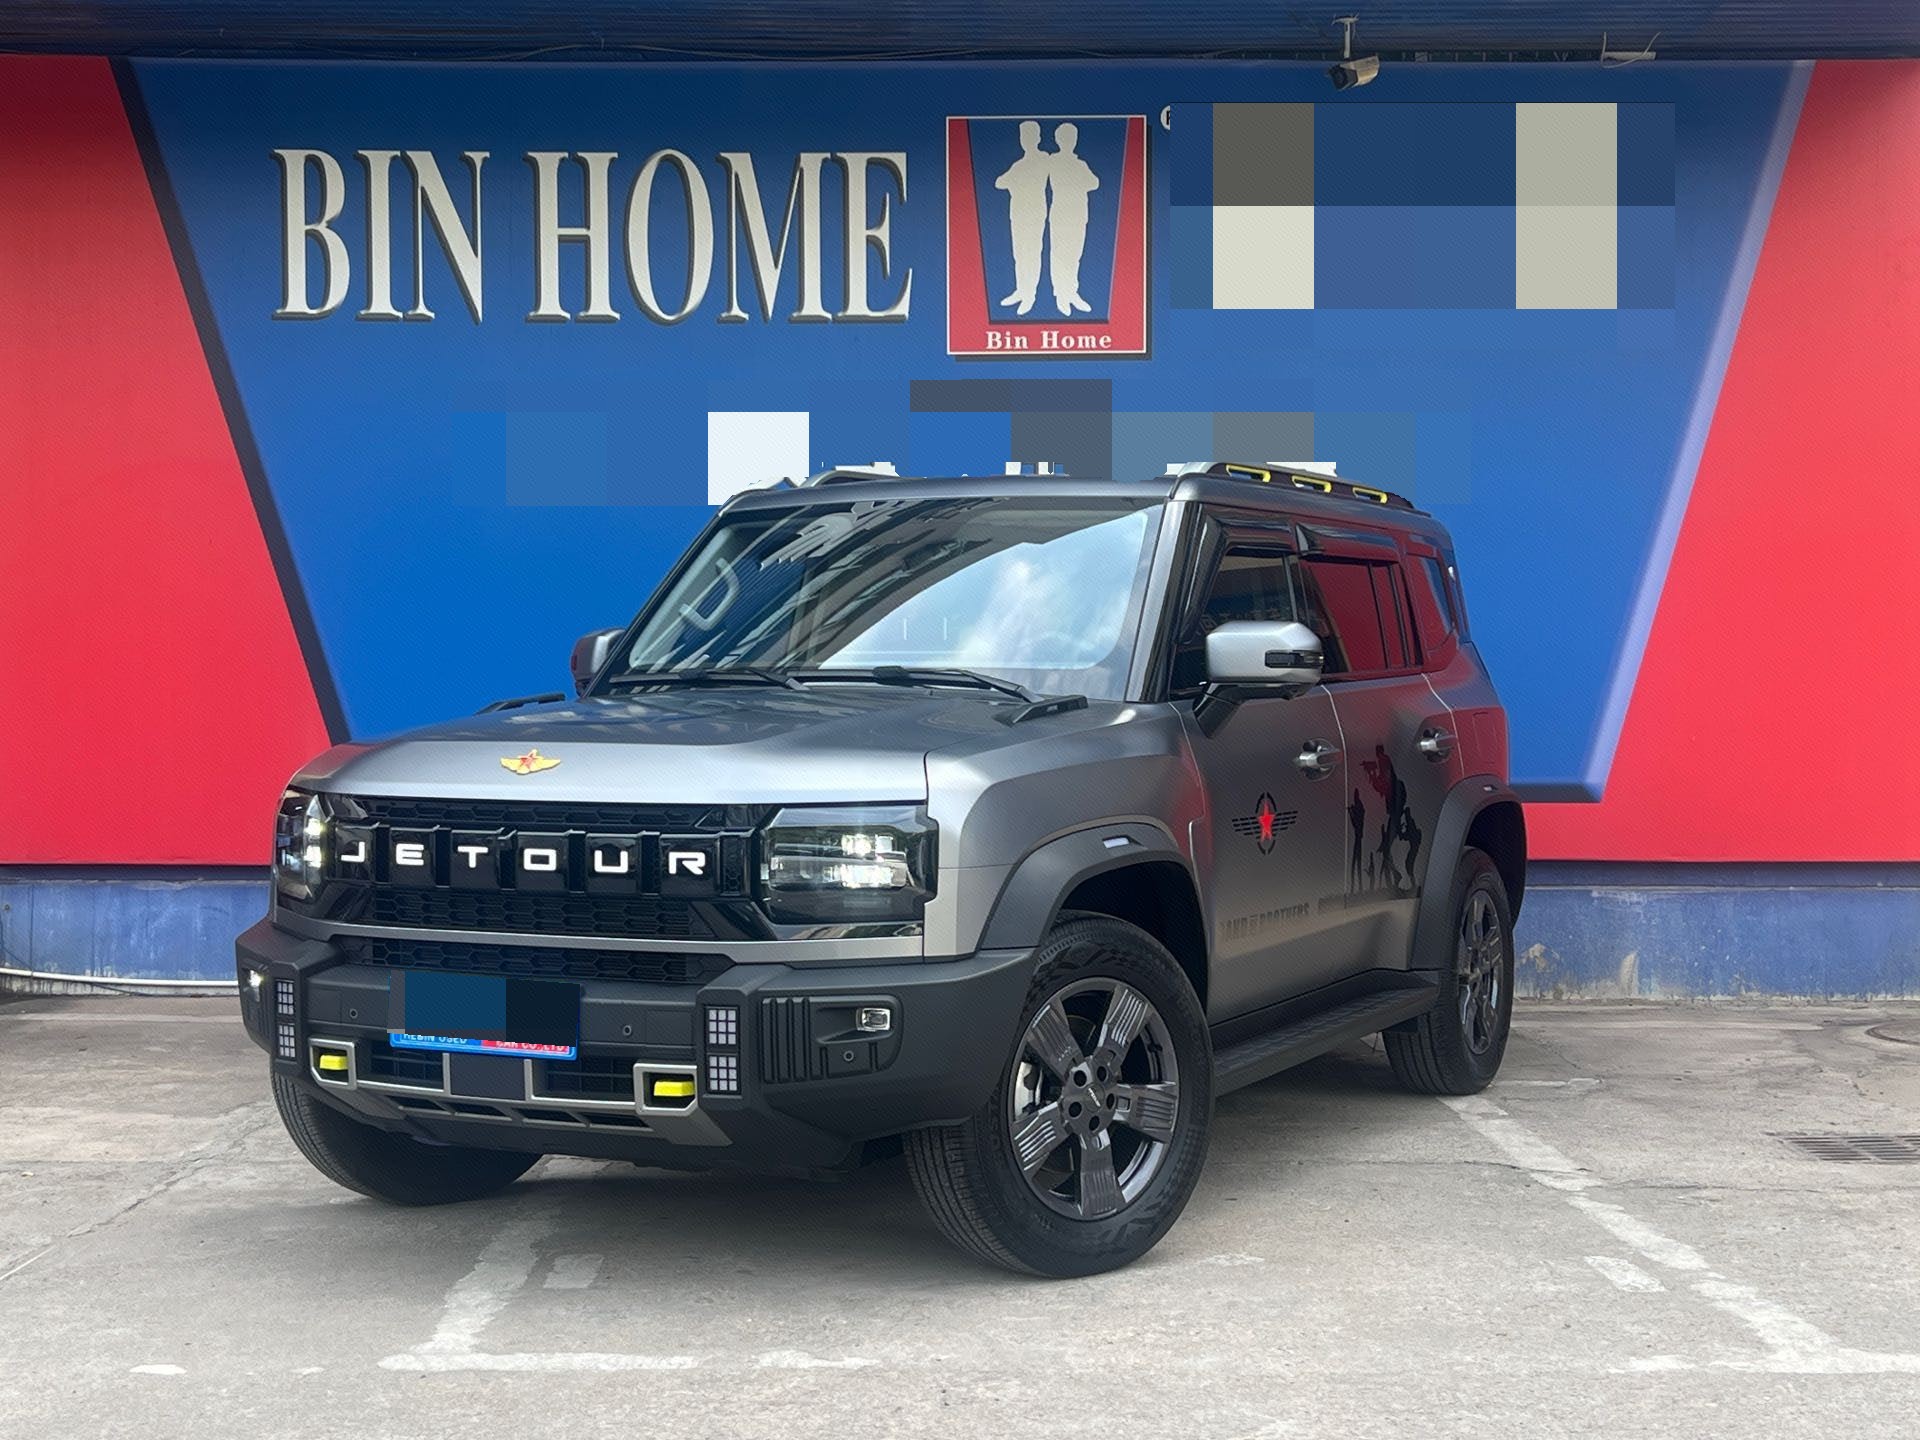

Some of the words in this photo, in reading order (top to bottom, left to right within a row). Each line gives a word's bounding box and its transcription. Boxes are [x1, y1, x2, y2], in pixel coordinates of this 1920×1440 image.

[270, 148, 491, 324] BIN
[523, 148, 914, 322] HOME
[985, 330, 1029, 350] Bin
[1040, 330, 1113, 350] Home
[340, 841, 706, 876] JETOUR
